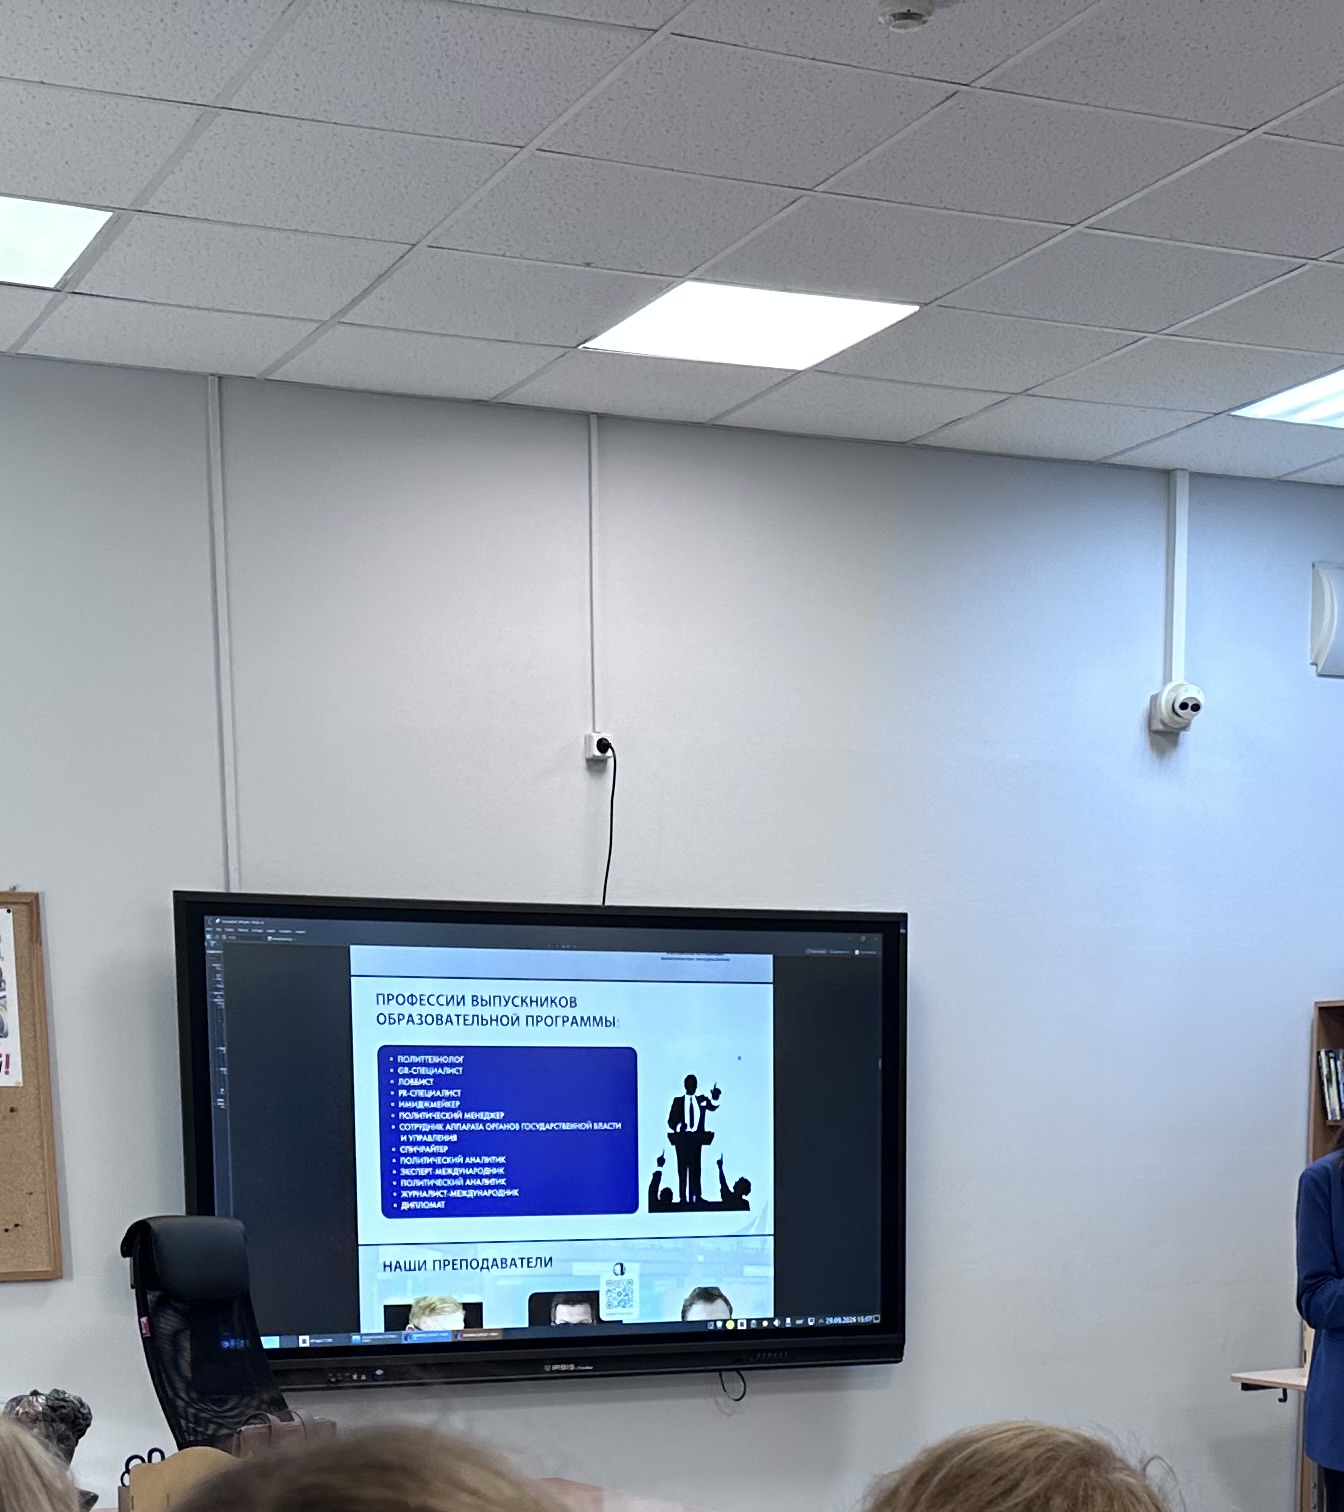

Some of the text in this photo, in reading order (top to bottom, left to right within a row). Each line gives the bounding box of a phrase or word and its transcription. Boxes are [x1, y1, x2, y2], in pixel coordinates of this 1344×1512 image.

[376, 993, 578, 1008] ПРОФЕССИИ ВЫПУСКНИКОВ
[376, 1012, 520, 1027] ОБРАЗОВАТЕЛЬНОЙ
[399, 1110, 462, 1119] ПОЛИТИЧЕСКИЙ
[445, 1123, 484, 1131] АППАРАТА
[400, 1134, 407, 1142] И
[400, 1155, 464, 1165] ПОЛИТИЧЕСКИЙ
[400, 1177, 464, 1187] ПОЛИТИЧЕСКИЙ
[383, 1256, 554, 1273] НАШИ ПРЕПОДАВАТЕЛИ
